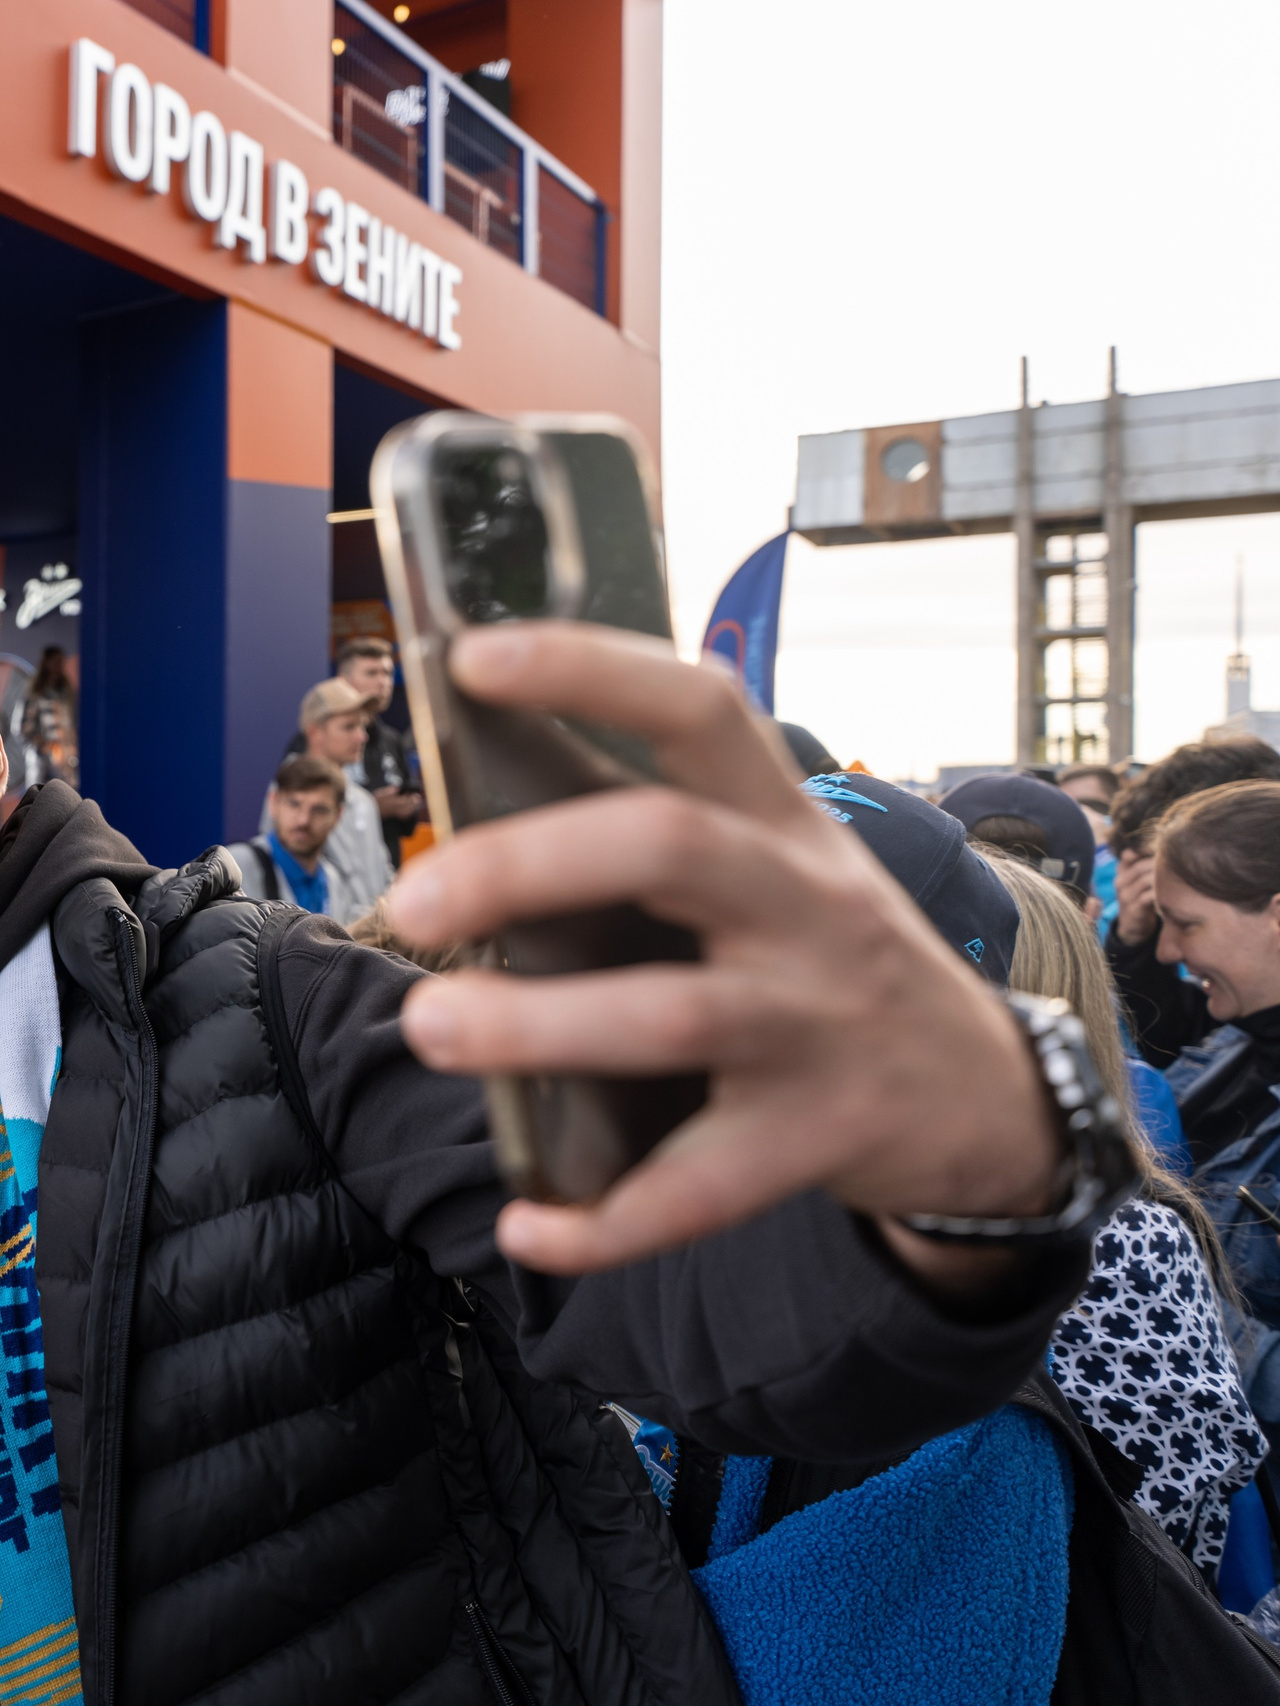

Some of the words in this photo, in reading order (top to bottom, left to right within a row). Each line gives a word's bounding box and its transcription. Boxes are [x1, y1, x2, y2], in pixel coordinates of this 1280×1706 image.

[68, 37, 266, 264] ГОРОД
[270, 158, 308, 266] В
[312, 187, 463, 351] ЗЕНИТЕ
